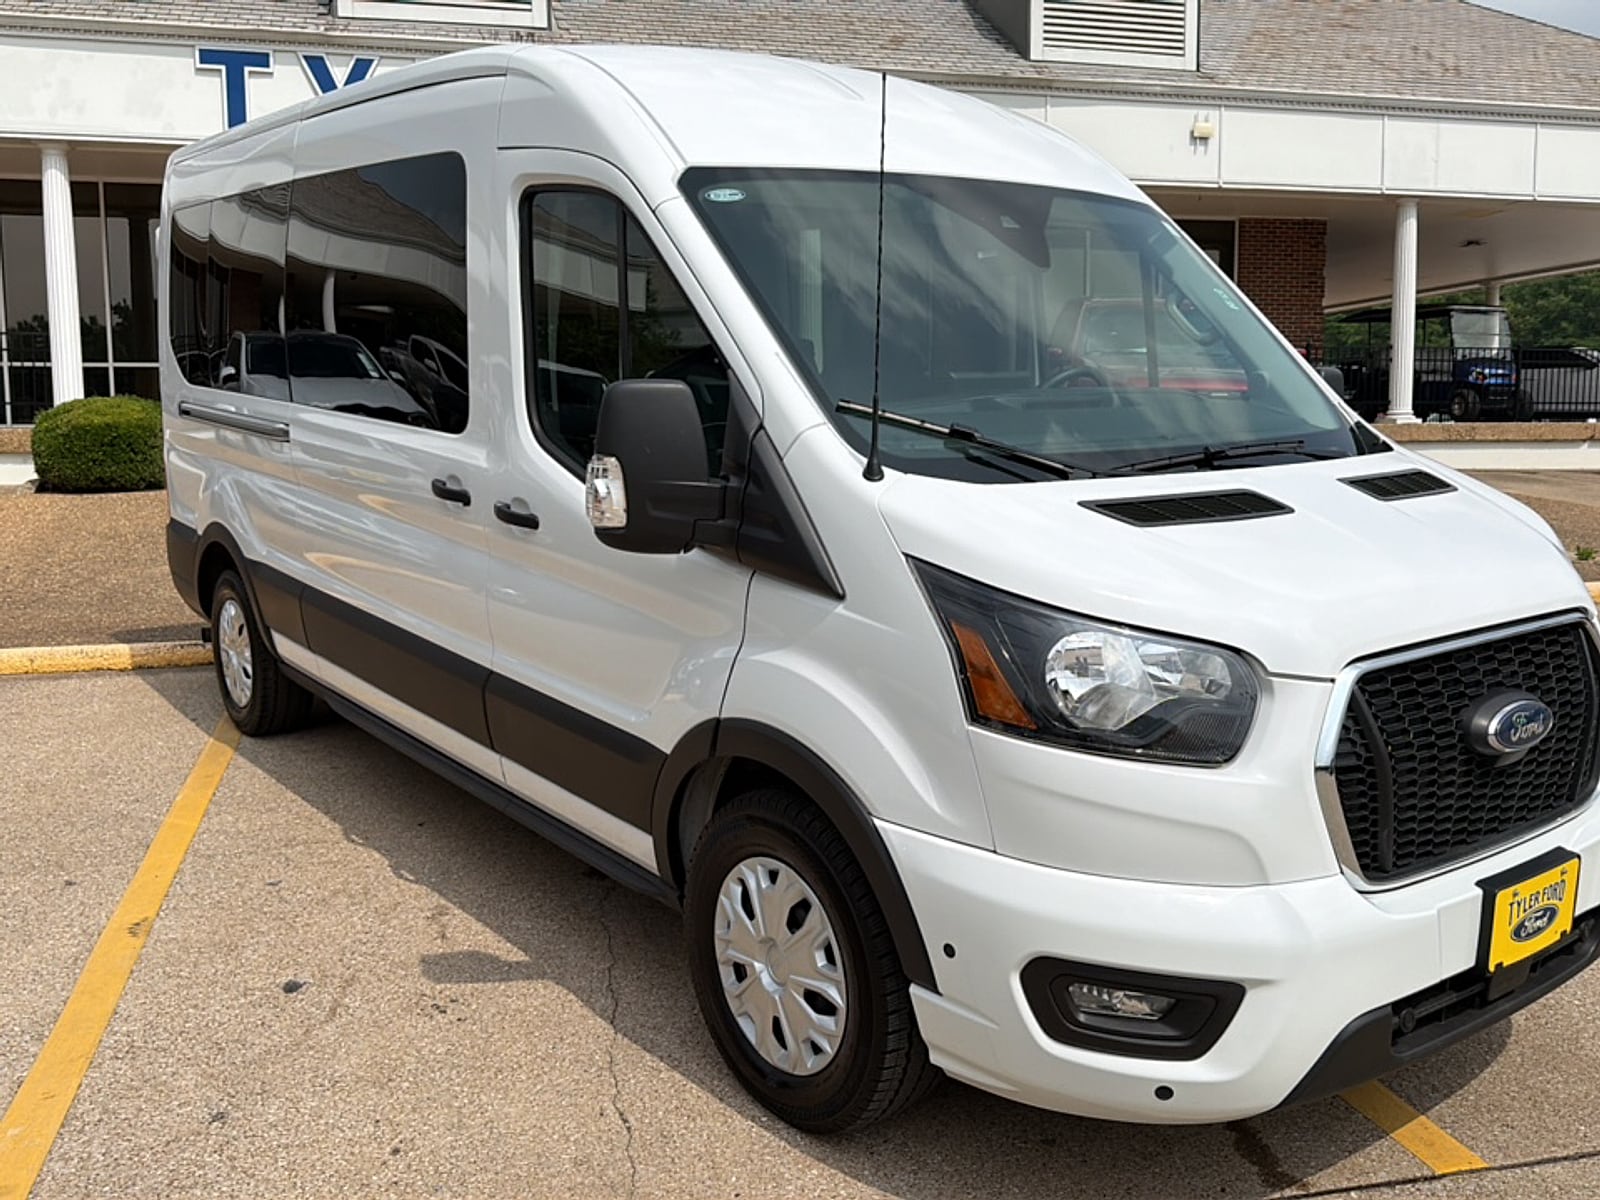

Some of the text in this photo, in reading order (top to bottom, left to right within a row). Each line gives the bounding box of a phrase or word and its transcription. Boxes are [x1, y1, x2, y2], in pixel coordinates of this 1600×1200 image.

[1510, 711, 1545, 742] Ford
[1508, 878, 1566, 927] TYLER FORD
[1520, 909, 1551, 937] Ford
